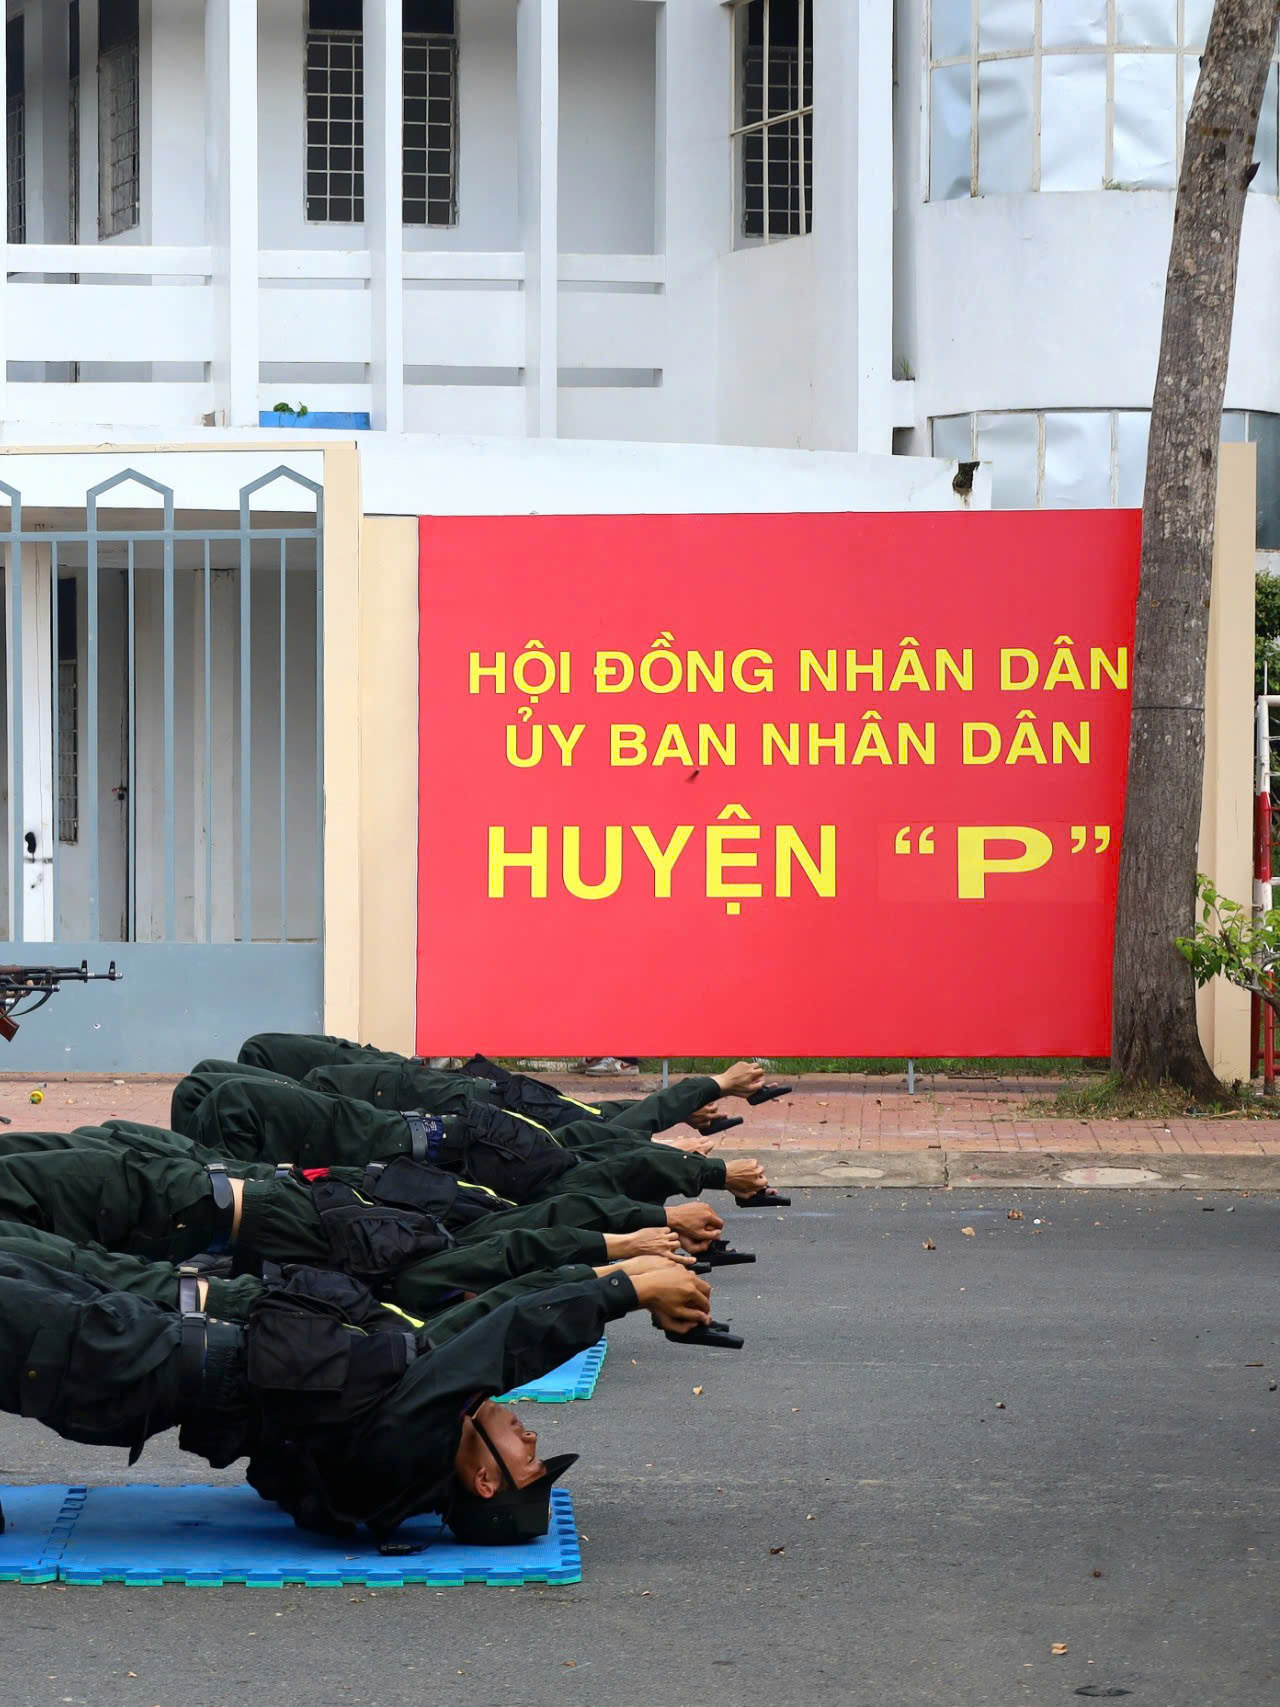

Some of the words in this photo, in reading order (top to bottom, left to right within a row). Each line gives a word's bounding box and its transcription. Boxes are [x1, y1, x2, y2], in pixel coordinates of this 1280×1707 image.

[469, 639, 571, 704] HỘI
[593, 631, 774, 694] ĐỒNG
[799, 636, 973, 692] NHÂN
[1000, 635, 1128, 691] DÂN
[506, 706, 586, 768] ỦY
[610, 723, 736, 767] BAN
[762, 710, 936, 766] NHÂN
[962, 709, 1090, 765] DÂN
[487, 803, 836, 916] HUYỆN
